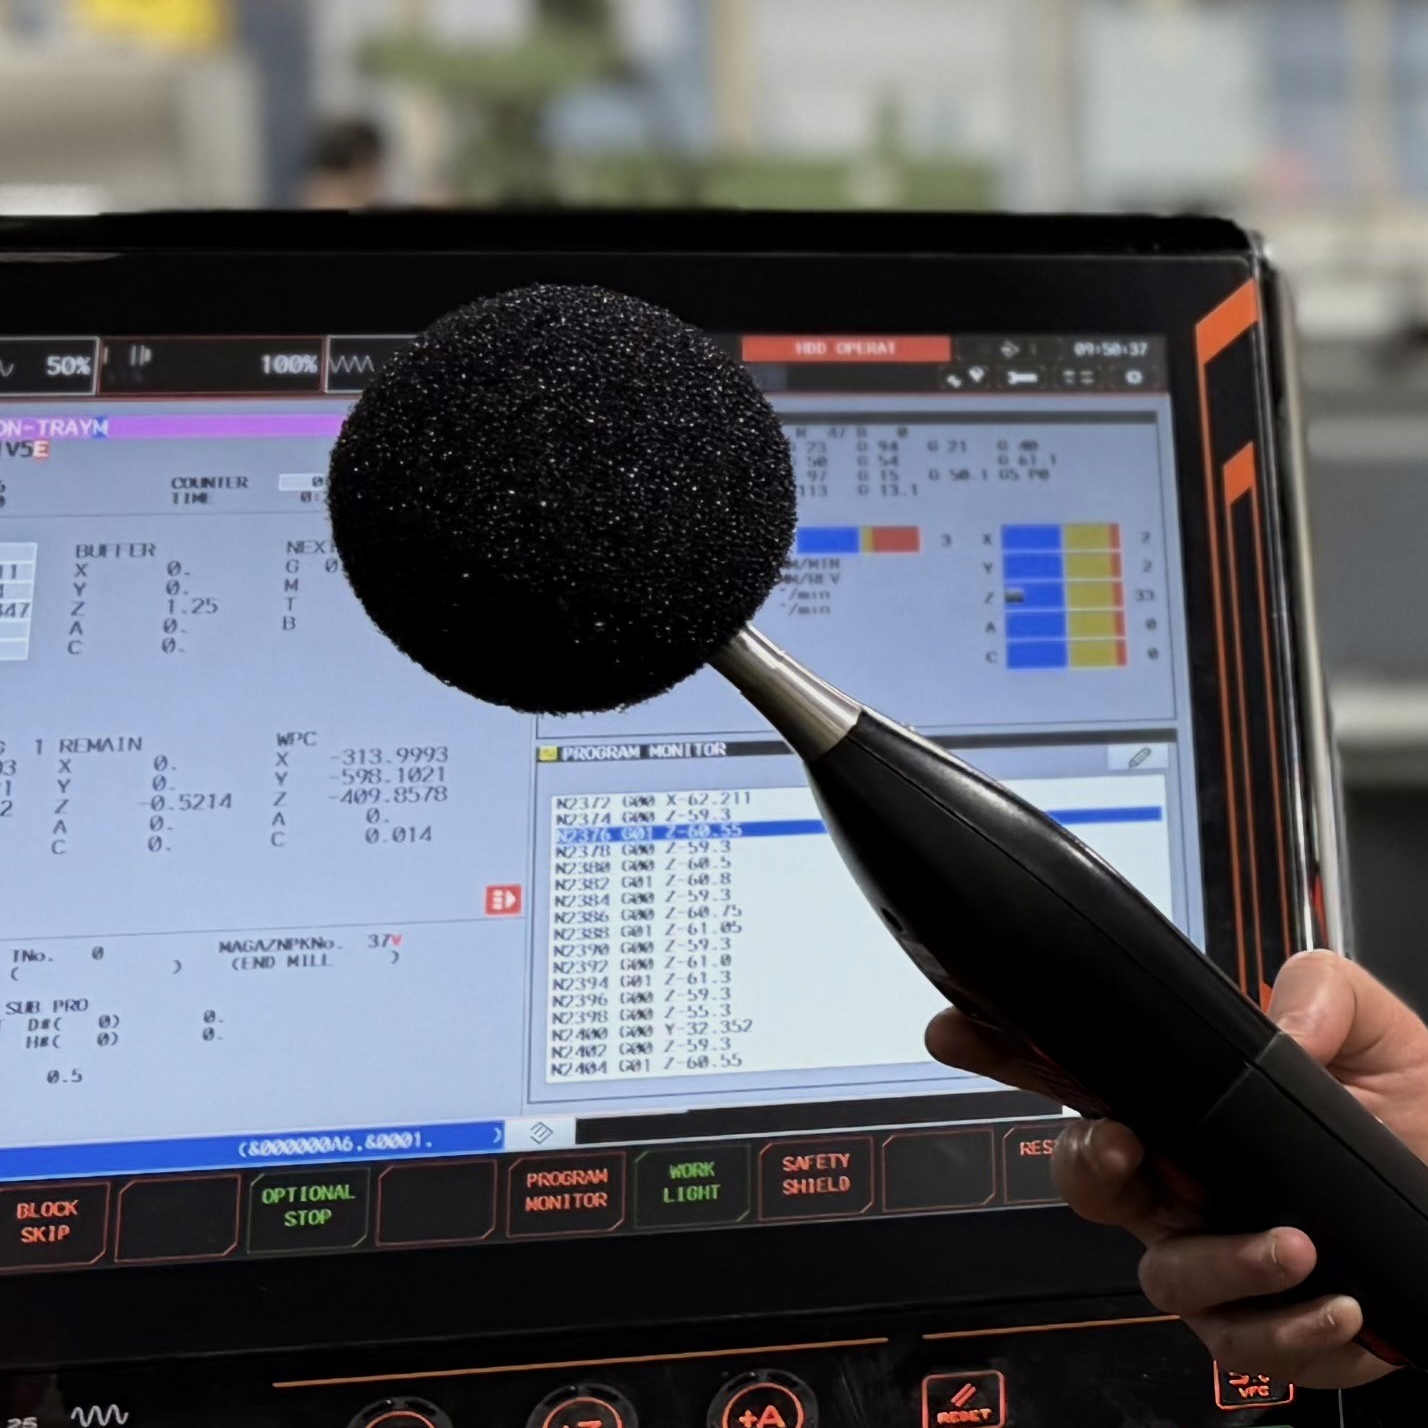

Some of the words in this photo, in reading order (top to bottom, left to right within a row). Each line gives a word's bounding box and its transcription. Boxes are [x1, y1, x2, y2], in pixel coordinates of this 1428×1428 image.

[1075, 342, 1147, 356] 09:50:37
[47, 356, 91, 376] 50%
[261, 355, 318, 375] 100%
[171, 477, 248, 489] COUNTER
[171, 492, 208, 504] TIME
[76, 543, 156, 558] BUFFER
[76, 563, 88, 577] X
[74, 583, 86, 597] Y
[284, 578, 299, 592] M
[71, 602, 85, 616] Z
[167, 598, 218, 615] 1.25
[286, 597, 296, 611] T
[69, 621, 83, 636] A
[283, 616, 296, 631] B
[68, 640, 82, 655] C
[36, 739, 43, 755] 1
[59, 737, 143, 754] REMAIN
[277, 731, 318, 747] WPC
[275, 752, 289, 767] X
[329, 746, 449, 765] -313.9993
[562, 745, 641, 761] PROGRAM
[649, 742, 727, 759] MONITOR
[58, 758, 72, 774] X
[275, 772, 288, 786] Y
[329, 766, 445, 785] -598.1021
[57, 779, 71, 794] Y
[54, 799, 69, 814] Z
[138, 793, 232, 811] -0.5214
[273, 791, 287, 807] Z
[329, 785, 448, 804] -409.8578
[52, 819, 67, 834] A
[272, 812, 286, 826] A
[271, 831, 286, 847] C
[365, 825, 432, 844] 0.014
[51, 839, 66, 855] C
[287, 954, 332, 968] MILL
[6, 1000, 40, 1015] SUB
[53, 998, 89, 1013] PRO
[46, 1068, 83, 1084] 0.5
[668, 1161, 715, 1178] WORK
[781, 1153, 850, 1172] SAFETY
[525, 1168, 608, 1188] PROGRAM
[782, 1175, 850, 1194] SHIELD
[262, 1184, 356, 1204] OPTIONAL
[524, 1192, 608, 1212] MONITOR
[663, 1184, 721, 1204] LIGHT
[16, 1199, 78, 1220] BLOCK
[284, 1209, 332, 1227] STOP
[21, 1224, 70, 1243] SKIP
[936, 1408, 993, 1425] RESET
